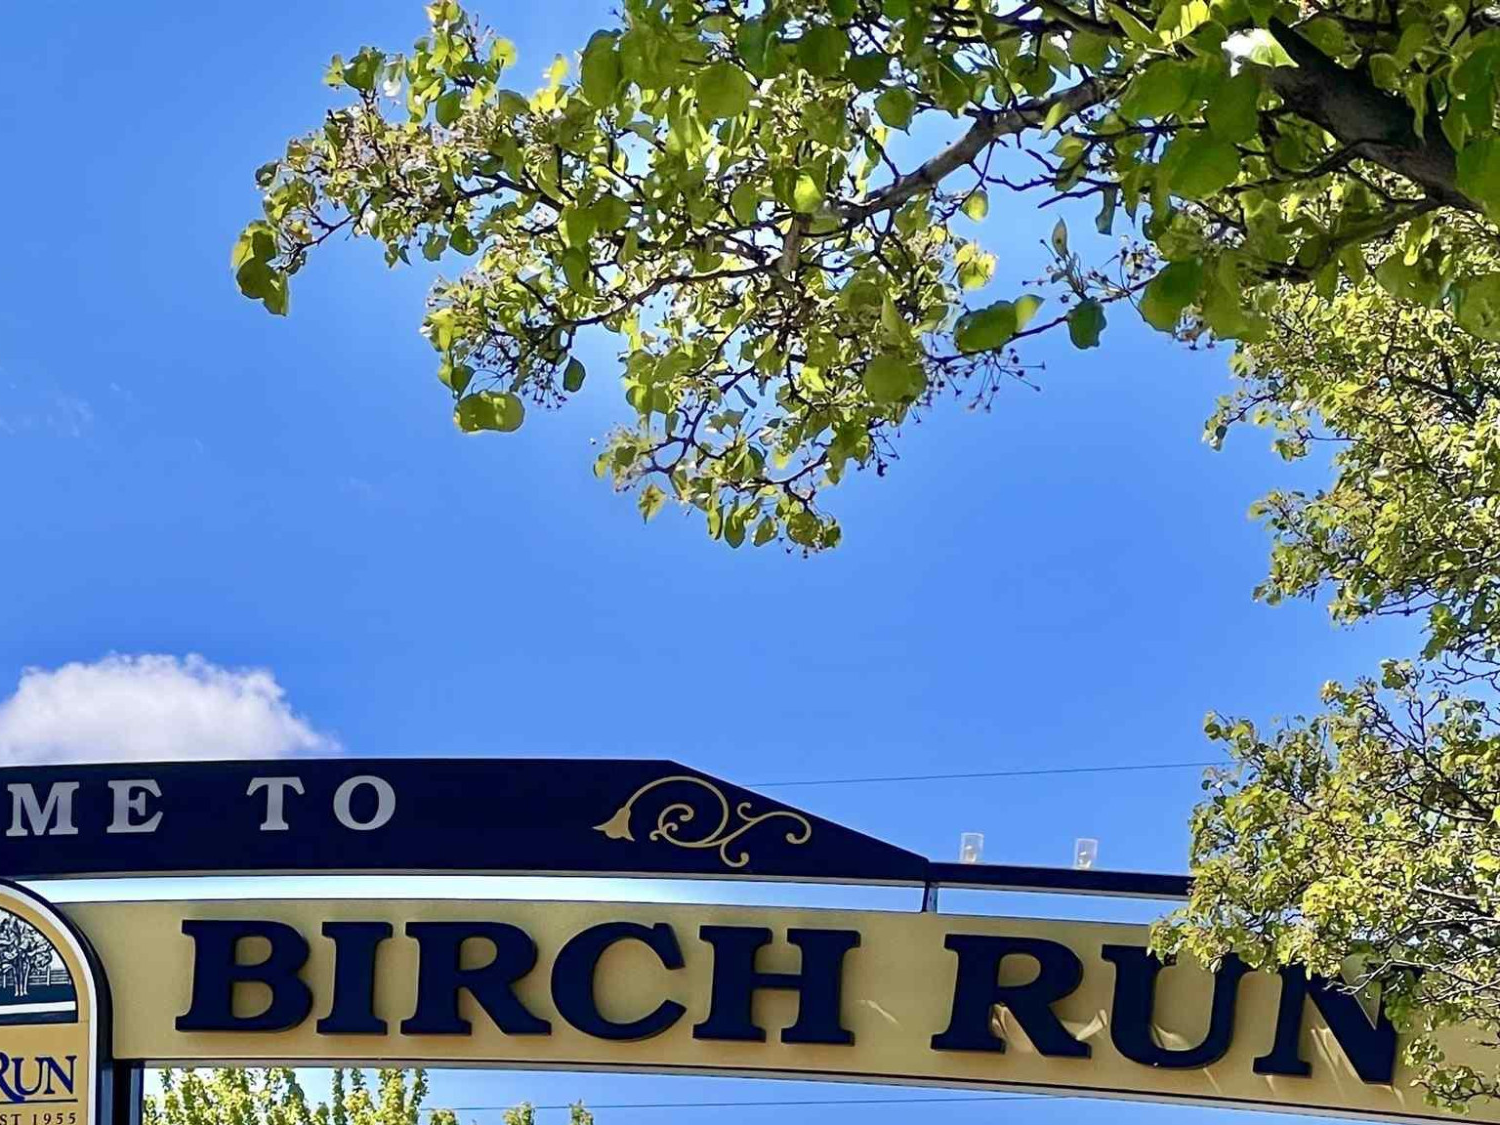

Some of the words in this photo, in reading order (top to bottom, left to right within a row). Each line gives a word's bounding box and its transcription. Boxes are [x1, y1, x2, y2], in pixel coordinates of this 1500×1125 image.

[247, 775, 396, 831] TO
[176, 919, 862, 1047] BIRCH
[931, 933, 1425, 1086] RUN
[32, 1112, 77, 1125] 1955
